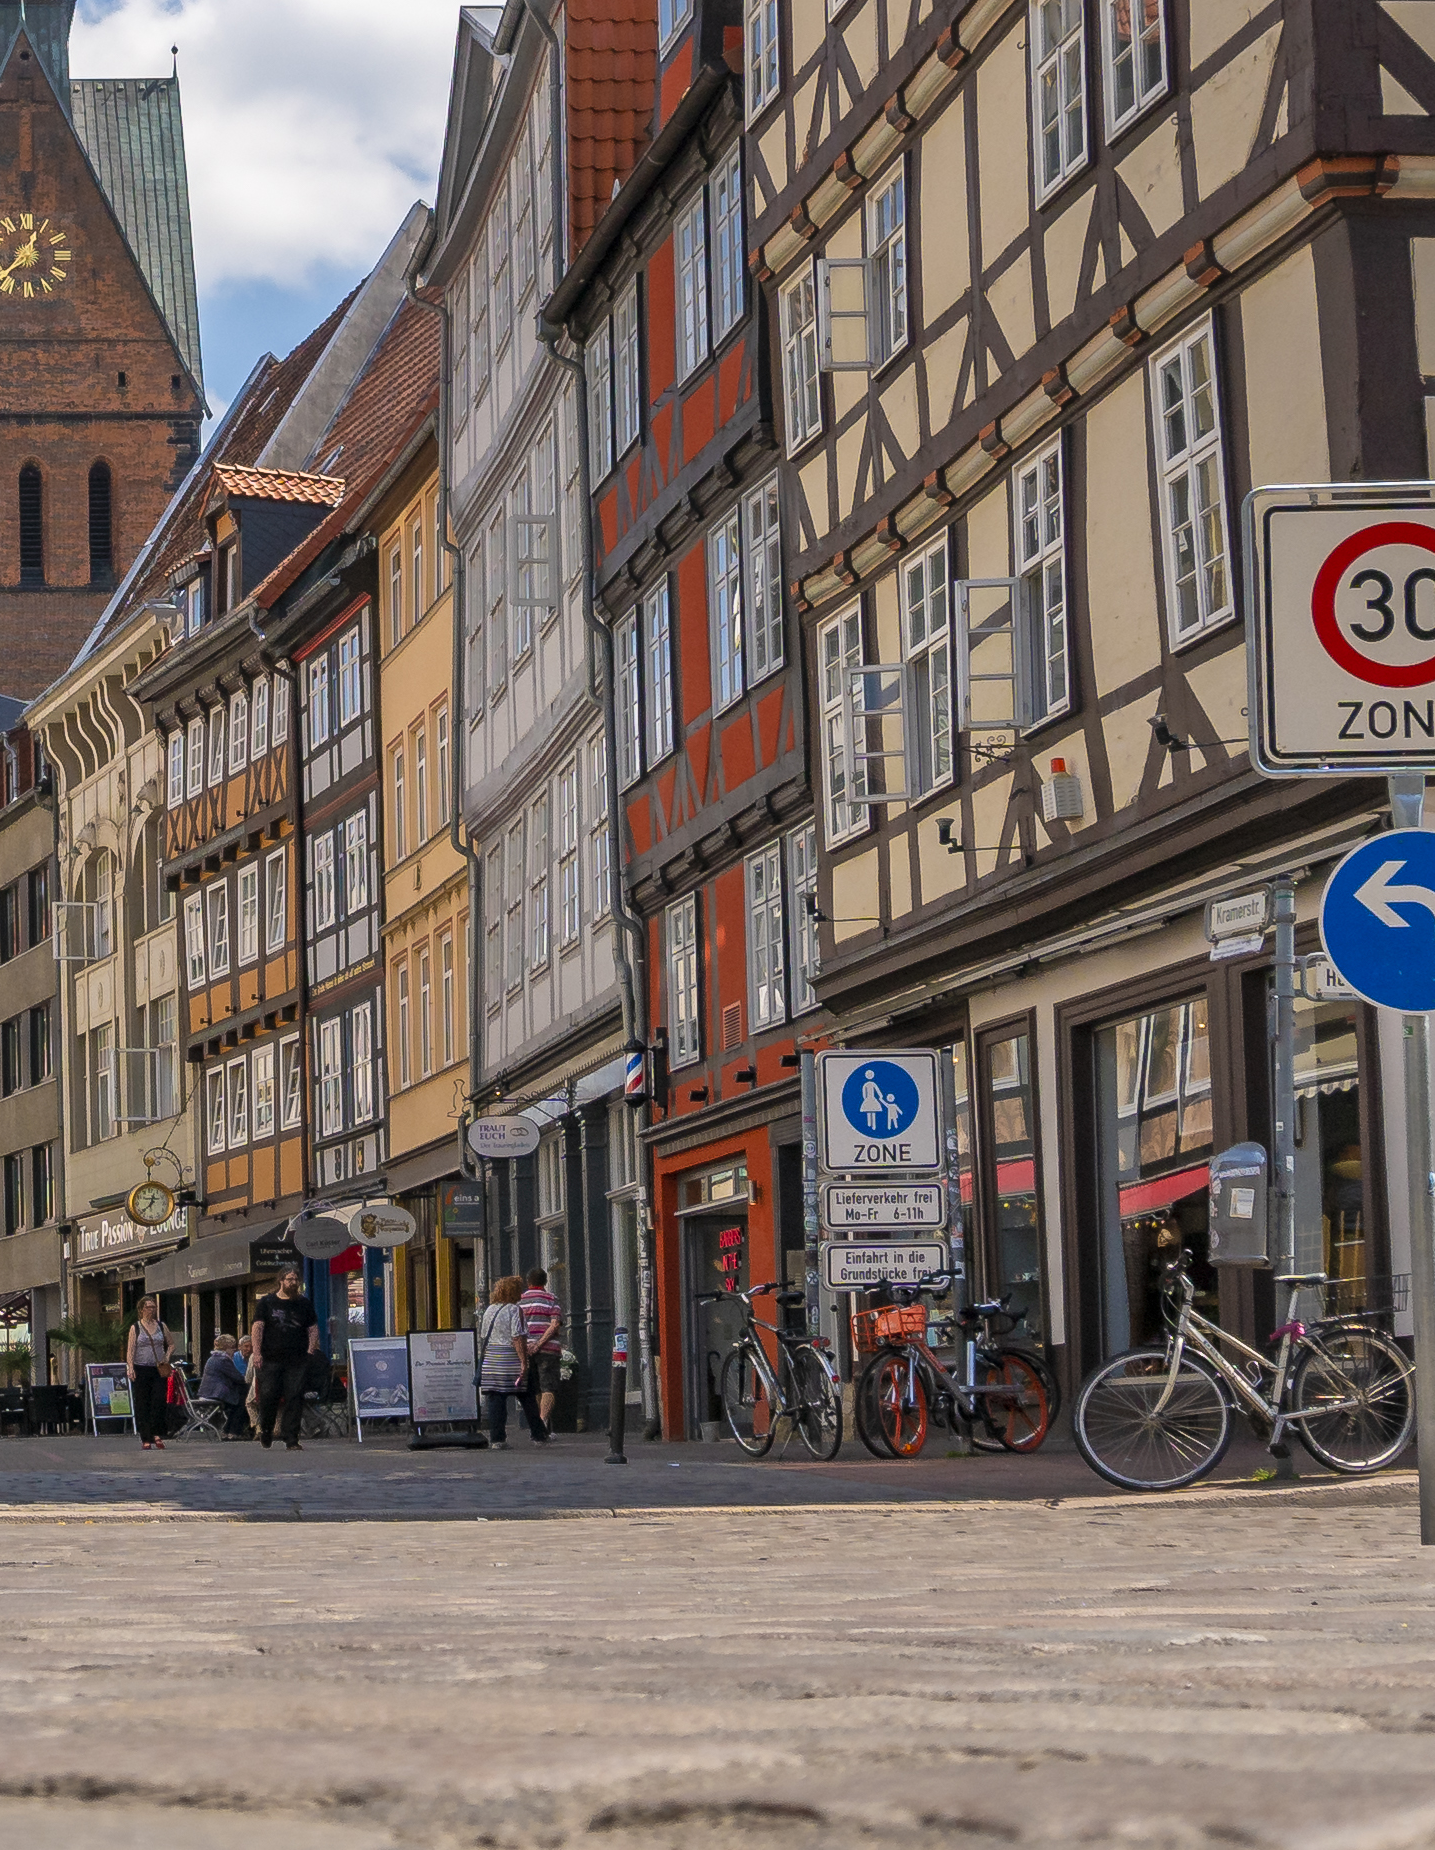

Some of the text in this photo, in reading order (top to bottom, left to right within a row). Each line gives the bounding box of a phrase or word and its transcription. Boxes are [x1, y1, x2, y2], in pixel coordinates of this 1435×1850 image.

[1216, 899, 1259, 925] Kramerstr.
[478, 1124, 506, 1132] TRAUT
[479, 1132, 505, 1140] EUCH
[853, 1144, 911, 1162] ZONE
[454, 1194, 472, 1202] eins
[835, 1191, 933, 1204] Lieferverkehr frei
[845, 1207, 924, 1220] Mo-Fr 6-11h
[80, 1226, 99, 1253] TRUE
[845, 1251, 925, 1264] Einfahrt in die
[841, 1266, 931, 1280] Grundstücke frei
